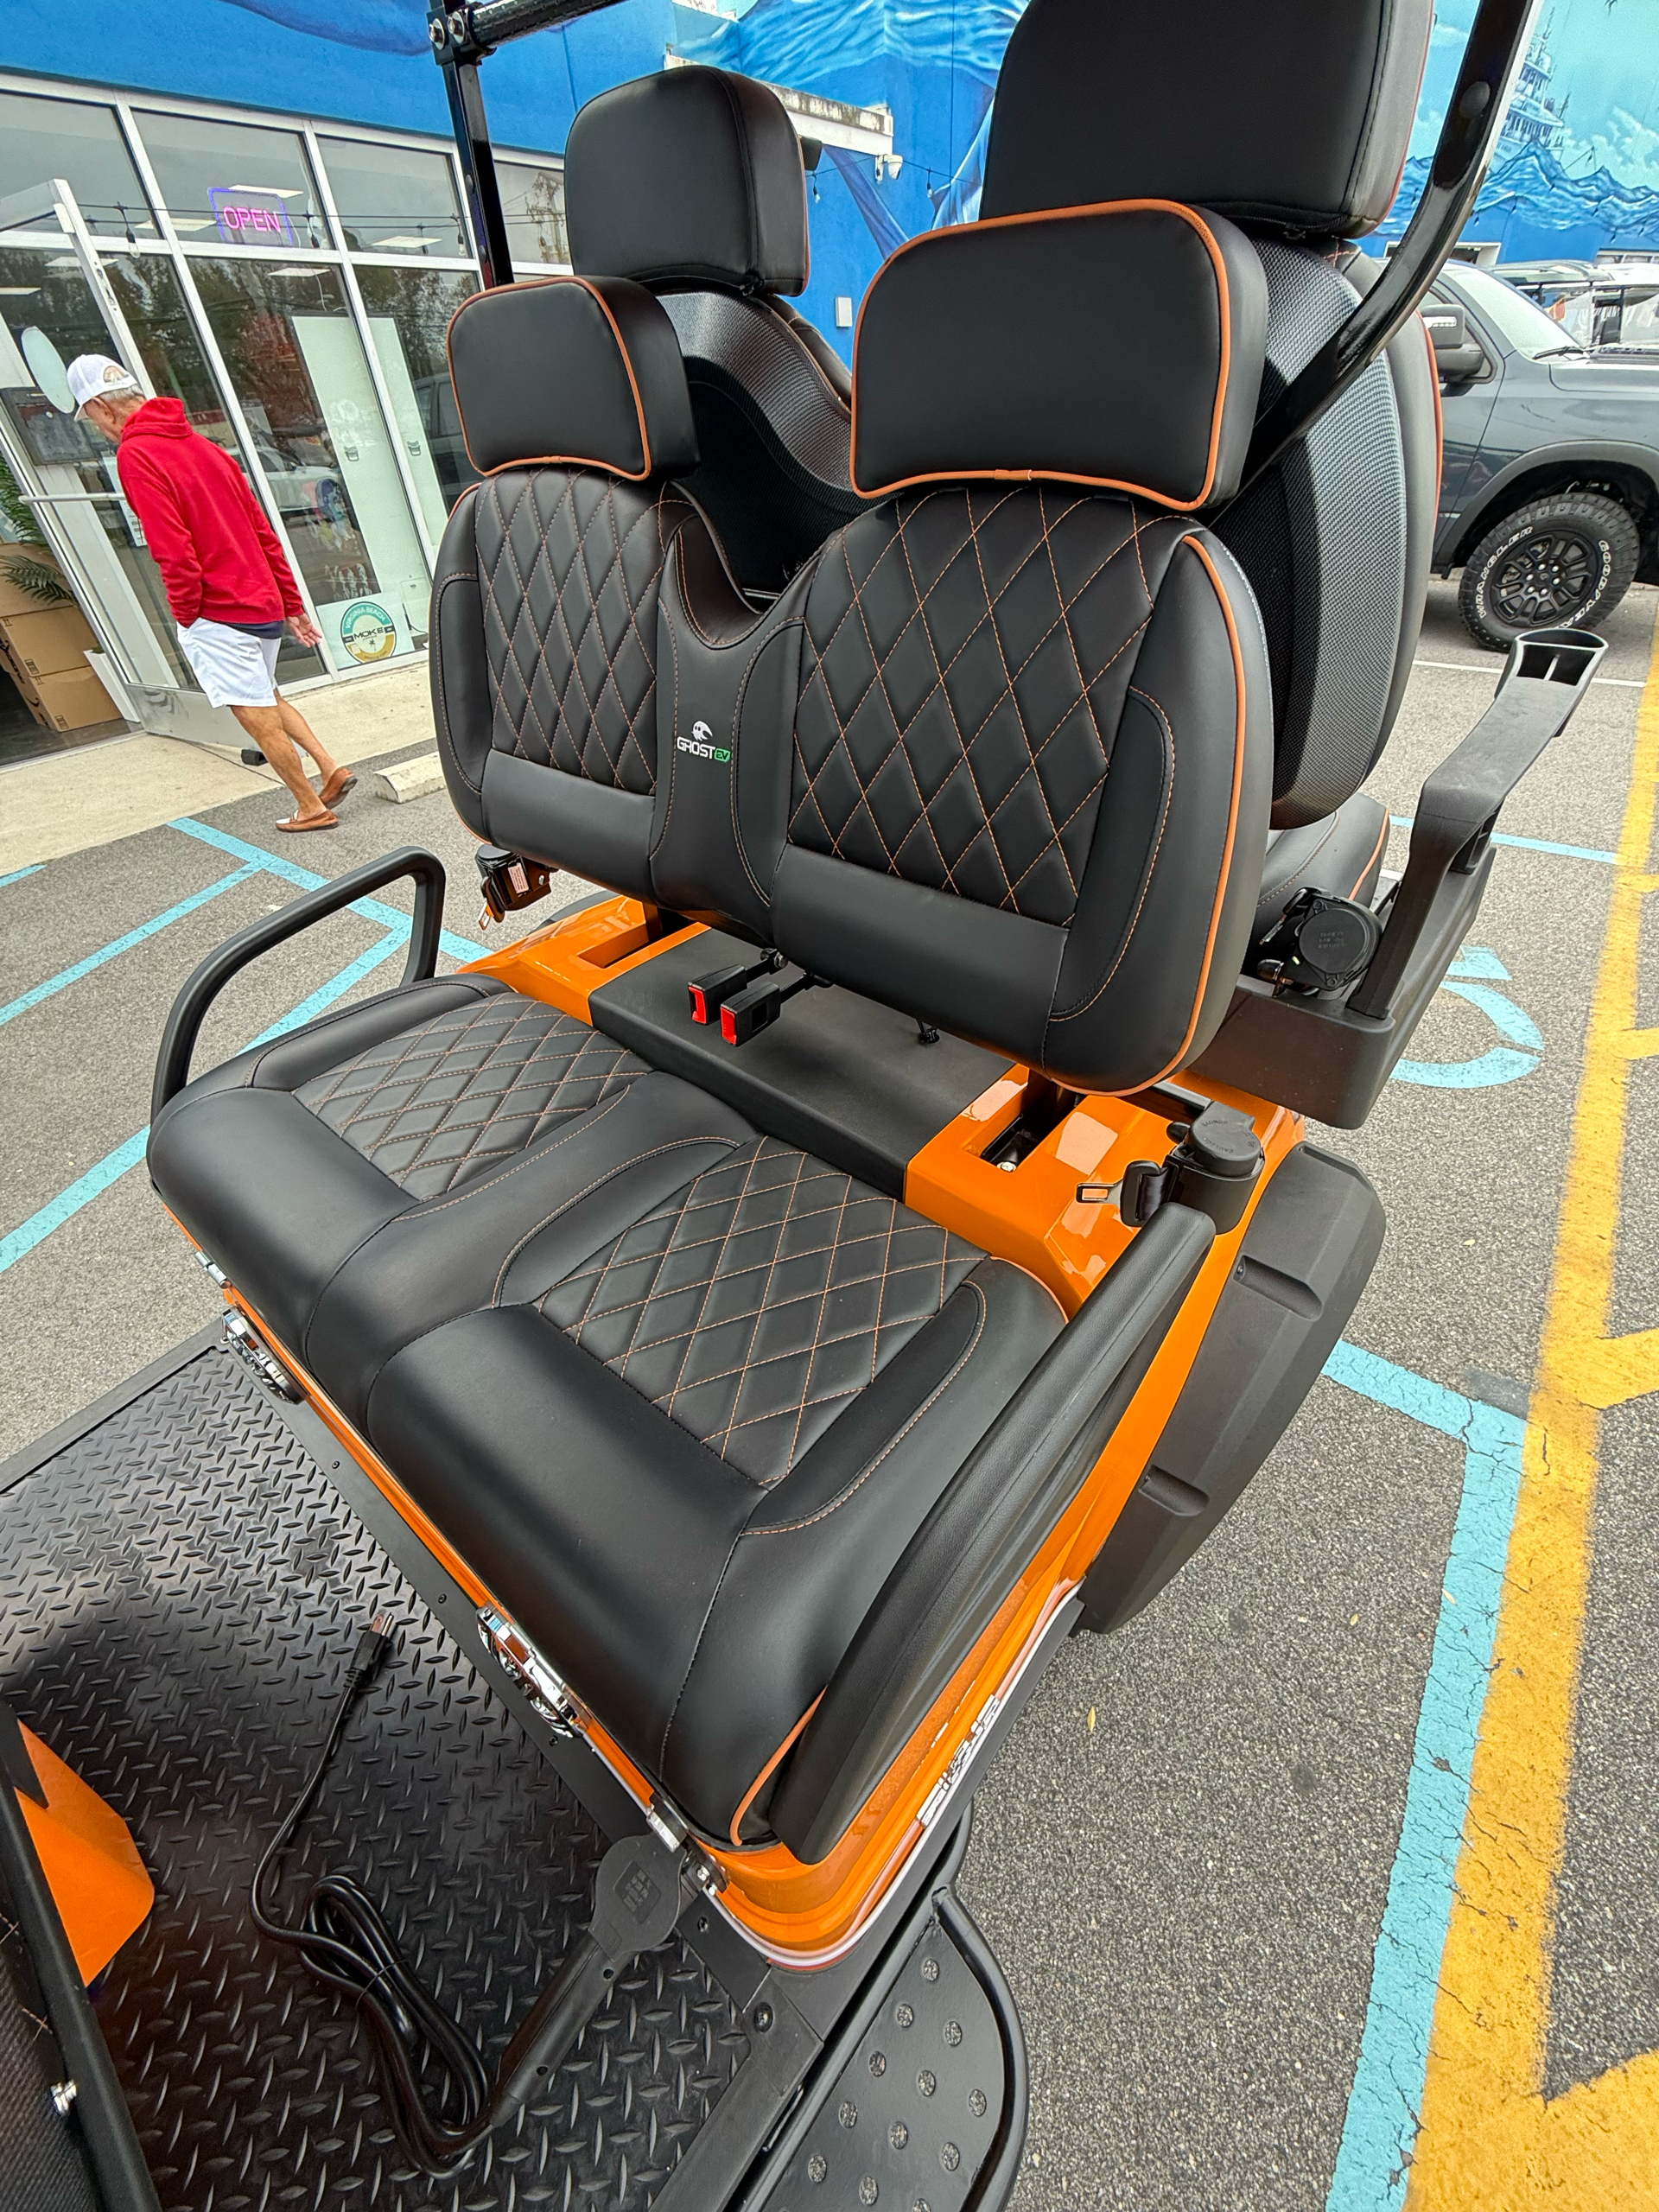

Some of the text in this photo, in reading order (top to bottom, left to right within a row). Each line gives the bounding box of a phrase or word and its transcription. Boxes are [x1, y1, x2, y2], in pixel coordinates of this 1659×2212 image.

[223, 206, 282, 232] OPEN
[1476, 526, 1533, 619] WRANGLER
[1554, 540, 1611, 628] GOODYEA
[346, 607, 386, 628] VIRGINIA BEACH
[353, 626, 385, 639] MOKE
